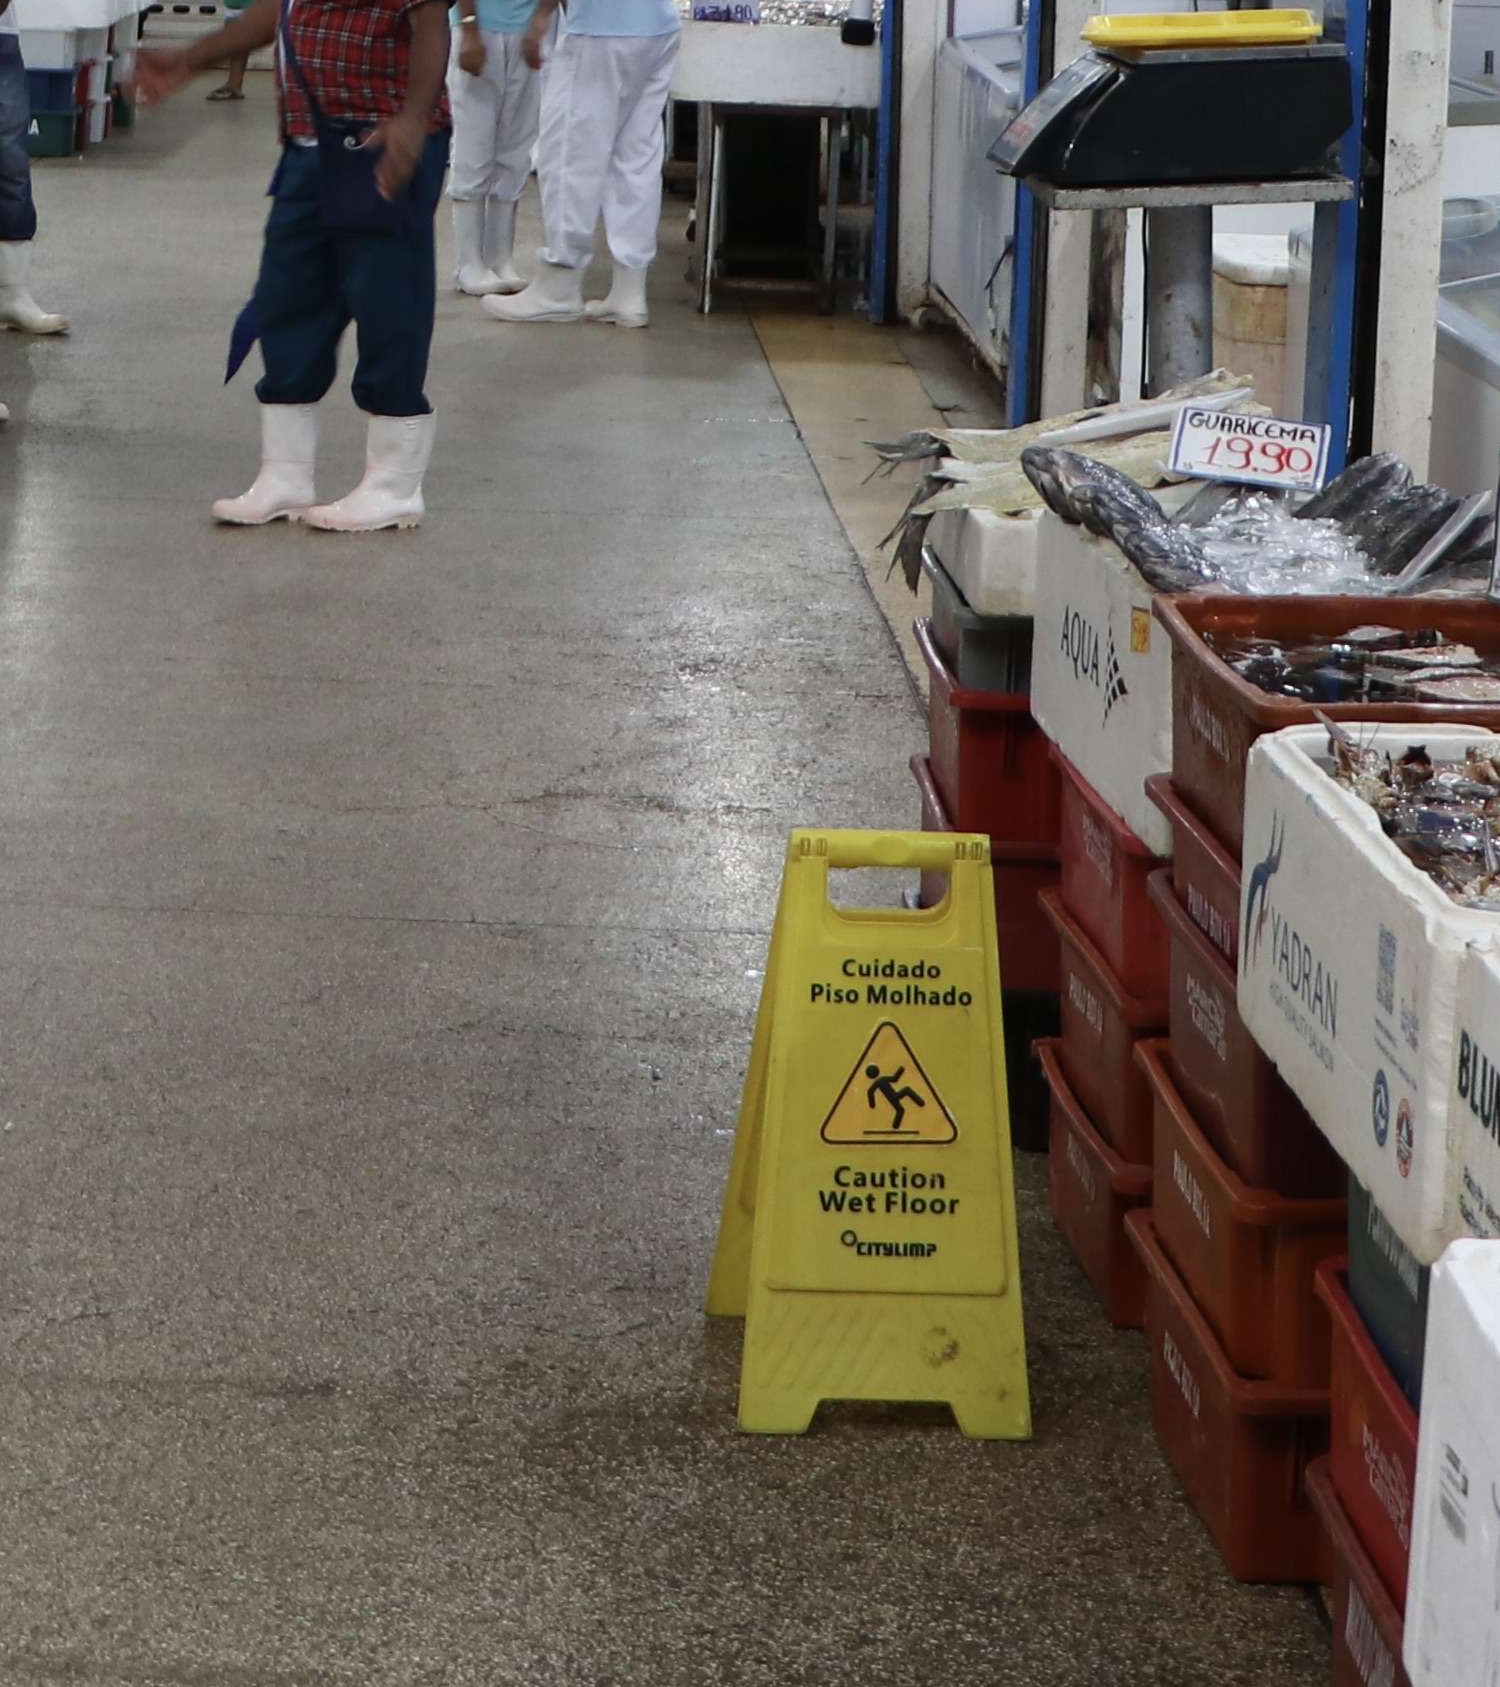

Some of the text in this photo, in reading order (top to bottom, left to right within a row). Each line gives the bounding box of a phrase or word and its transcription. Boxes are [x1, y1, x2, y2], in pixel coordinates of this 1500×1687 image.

[1188, 411, 1317, 444] GUARICEMA
[1060, 603, 1100, 689] AQUA
[840, 958, 942, 981] Cuidado
[1270, 904, 1339, 1041] YADRAN
[809, 981, 974, 1008] Piso Molhado
[832, 1165, 946, 1191] Caution
[817, 1190, 960, 1217] Wet Floor
